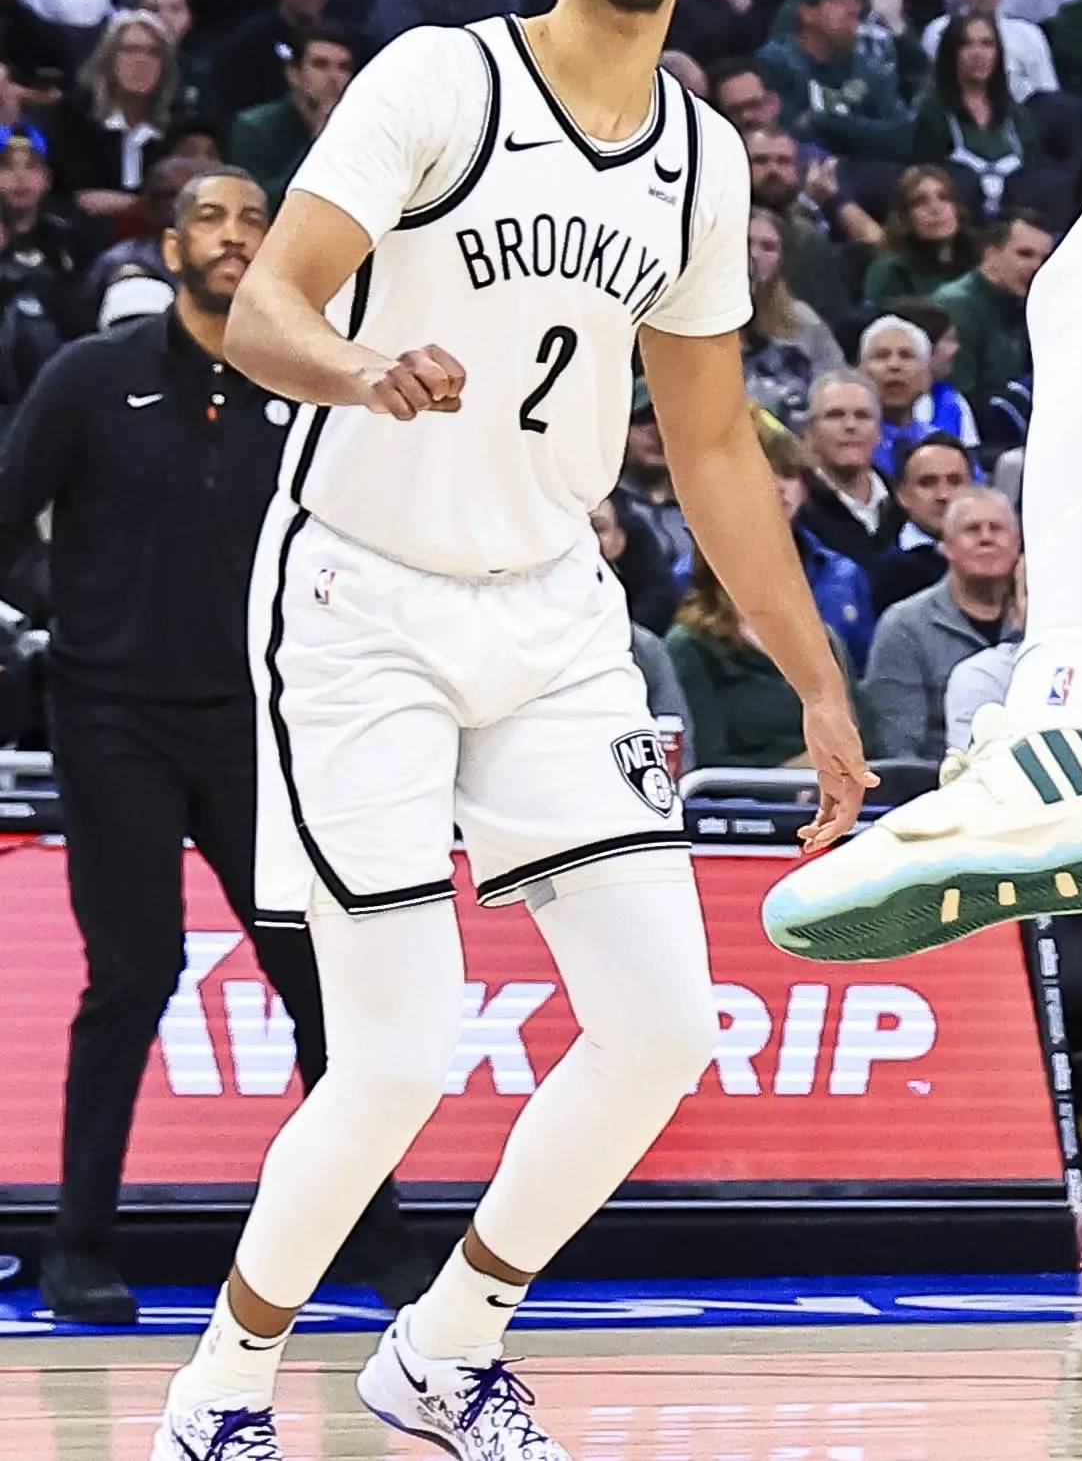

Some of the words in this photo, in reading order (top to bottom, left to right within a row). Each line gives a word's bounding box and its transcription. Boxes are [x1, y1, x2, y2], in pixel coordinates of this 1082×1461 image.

[456, 214, 668, 326] BROOKLYN
[519, 325, 578, 434] 2
[684, 981, 939, 1096] RIP
